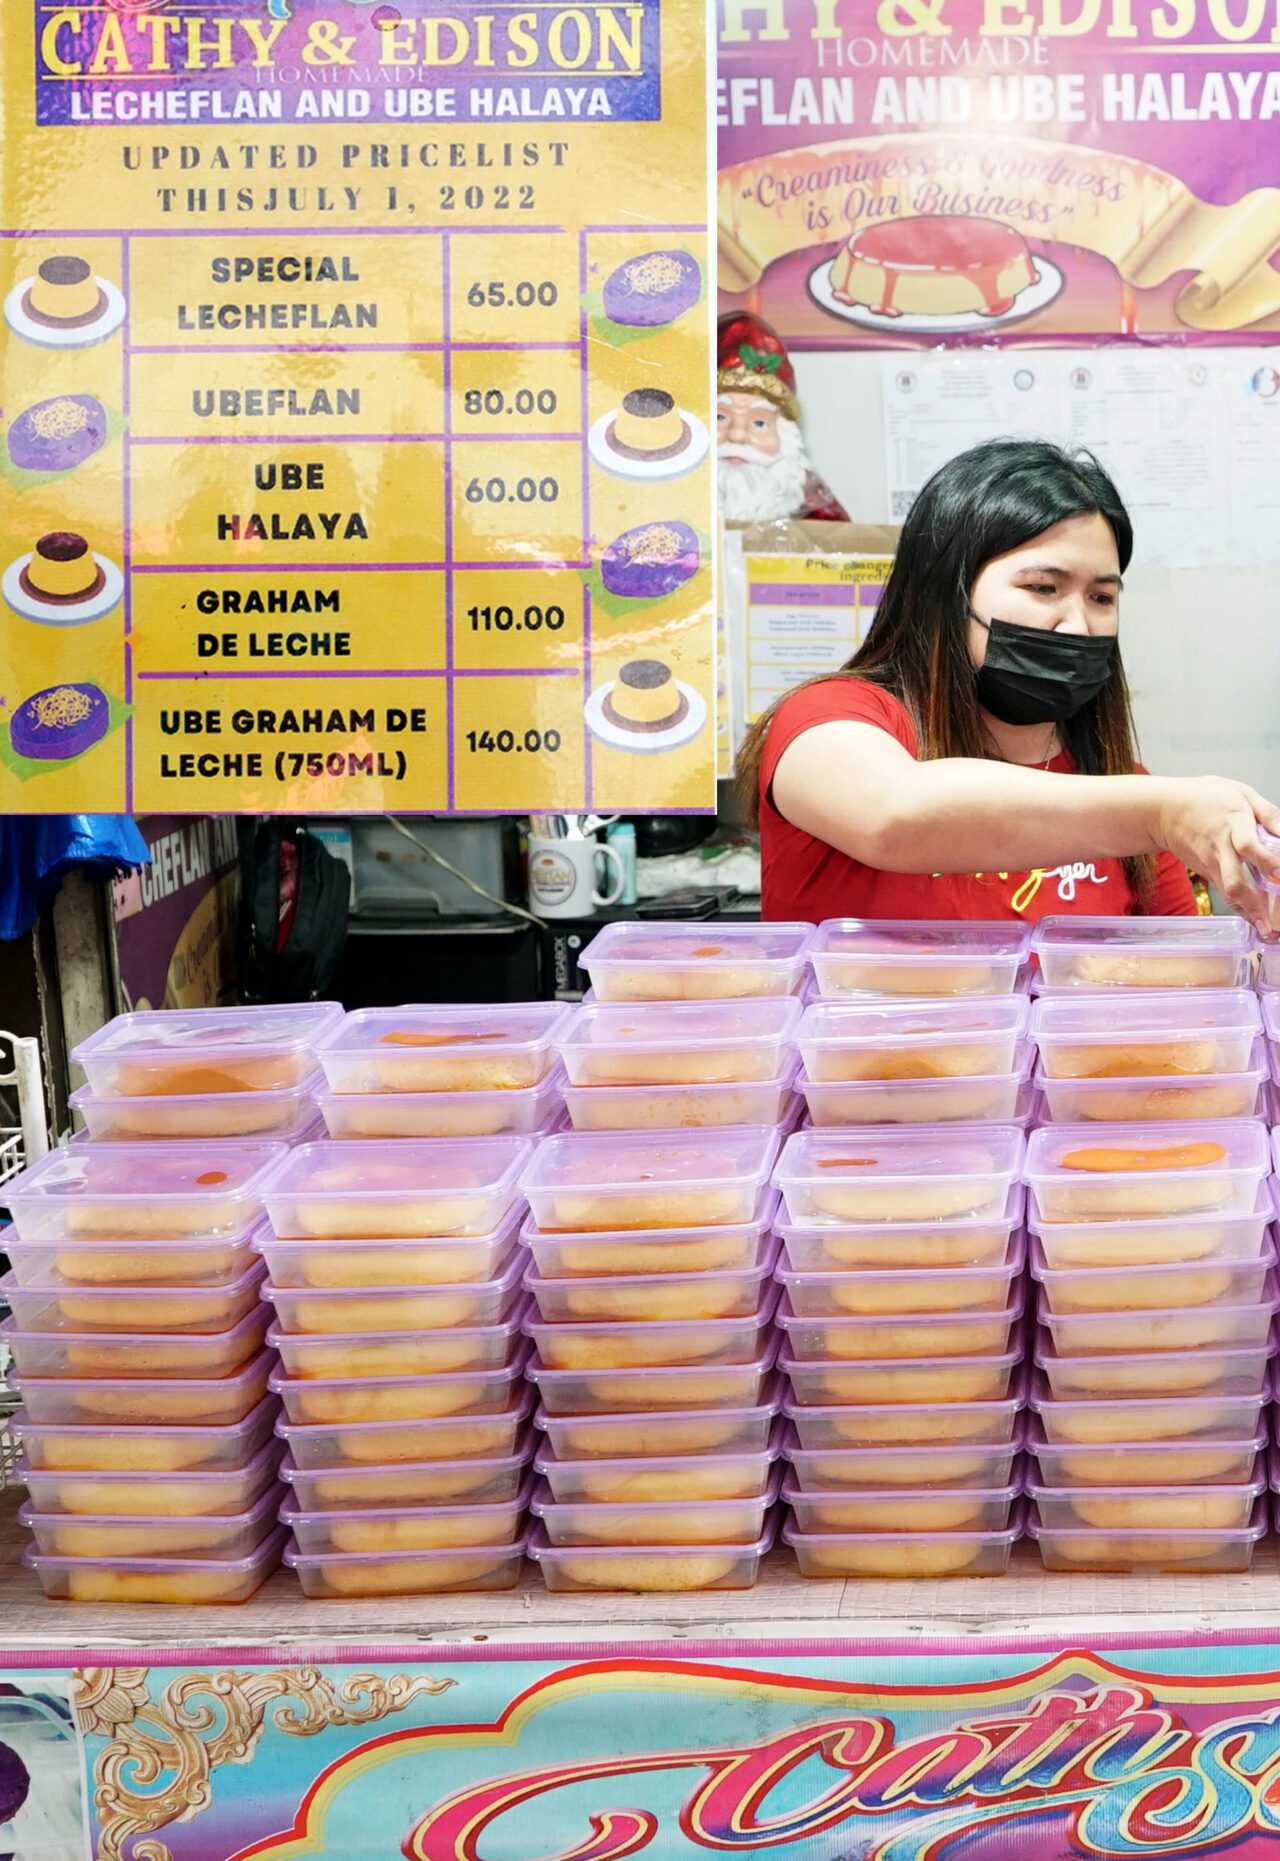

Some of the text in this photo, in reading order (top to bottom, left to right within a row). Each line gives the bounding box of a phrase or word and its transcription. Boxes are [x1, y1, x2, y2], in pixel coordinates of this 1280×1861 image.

[877, 0, 961, 39] &
[41, 8, 644, 76] CATHY & EDISON
[816, 36, 1050, 68] HOMEMADE
[254, 66, 425, 84] HOMEMADE
[71, 86, 612, 120] LECHEFLAN AND UBE HALAYA
[871, 74, 985, 125] AND
[1000, 74, 1085, 122] UBE
[122, 141, 571, 170] UPDATED PRICELIST
[980, 148, 1127, 201] Goodness
[157, 185, 537, 214] THISJULY 1, 2022
[806, 201, 833, 231] is
[845, 188, 900, 222] Our
[211, 256, 360, 283] SPECIAL
[466, 282, 559, 309] 65.00
[177, 304, 379, 330] LECHEFLAN
[192, 388, 362, 416] UBEFLAN
[463, 389, 558, 416] 80.00
[254, 463, 325, 491] UBE
[464, 477, 559, 503] 60.00
[217, 513, 369, 541] HALAYA
[196, 589, 341, 614] GRAHAM
[467, 605, 566, 631] 110.00
[197, 631, 352, 657] DE LECHE
[160, 707, 427, 735] UBE GRAHAM DE
[466, 729, 562, 754] 140.00
[160, 749, 408, 781] LECHE (750ML)
[141, 818, 211, 908] CHEFLAN
[554, 936, 570, 990] MEGABOX
